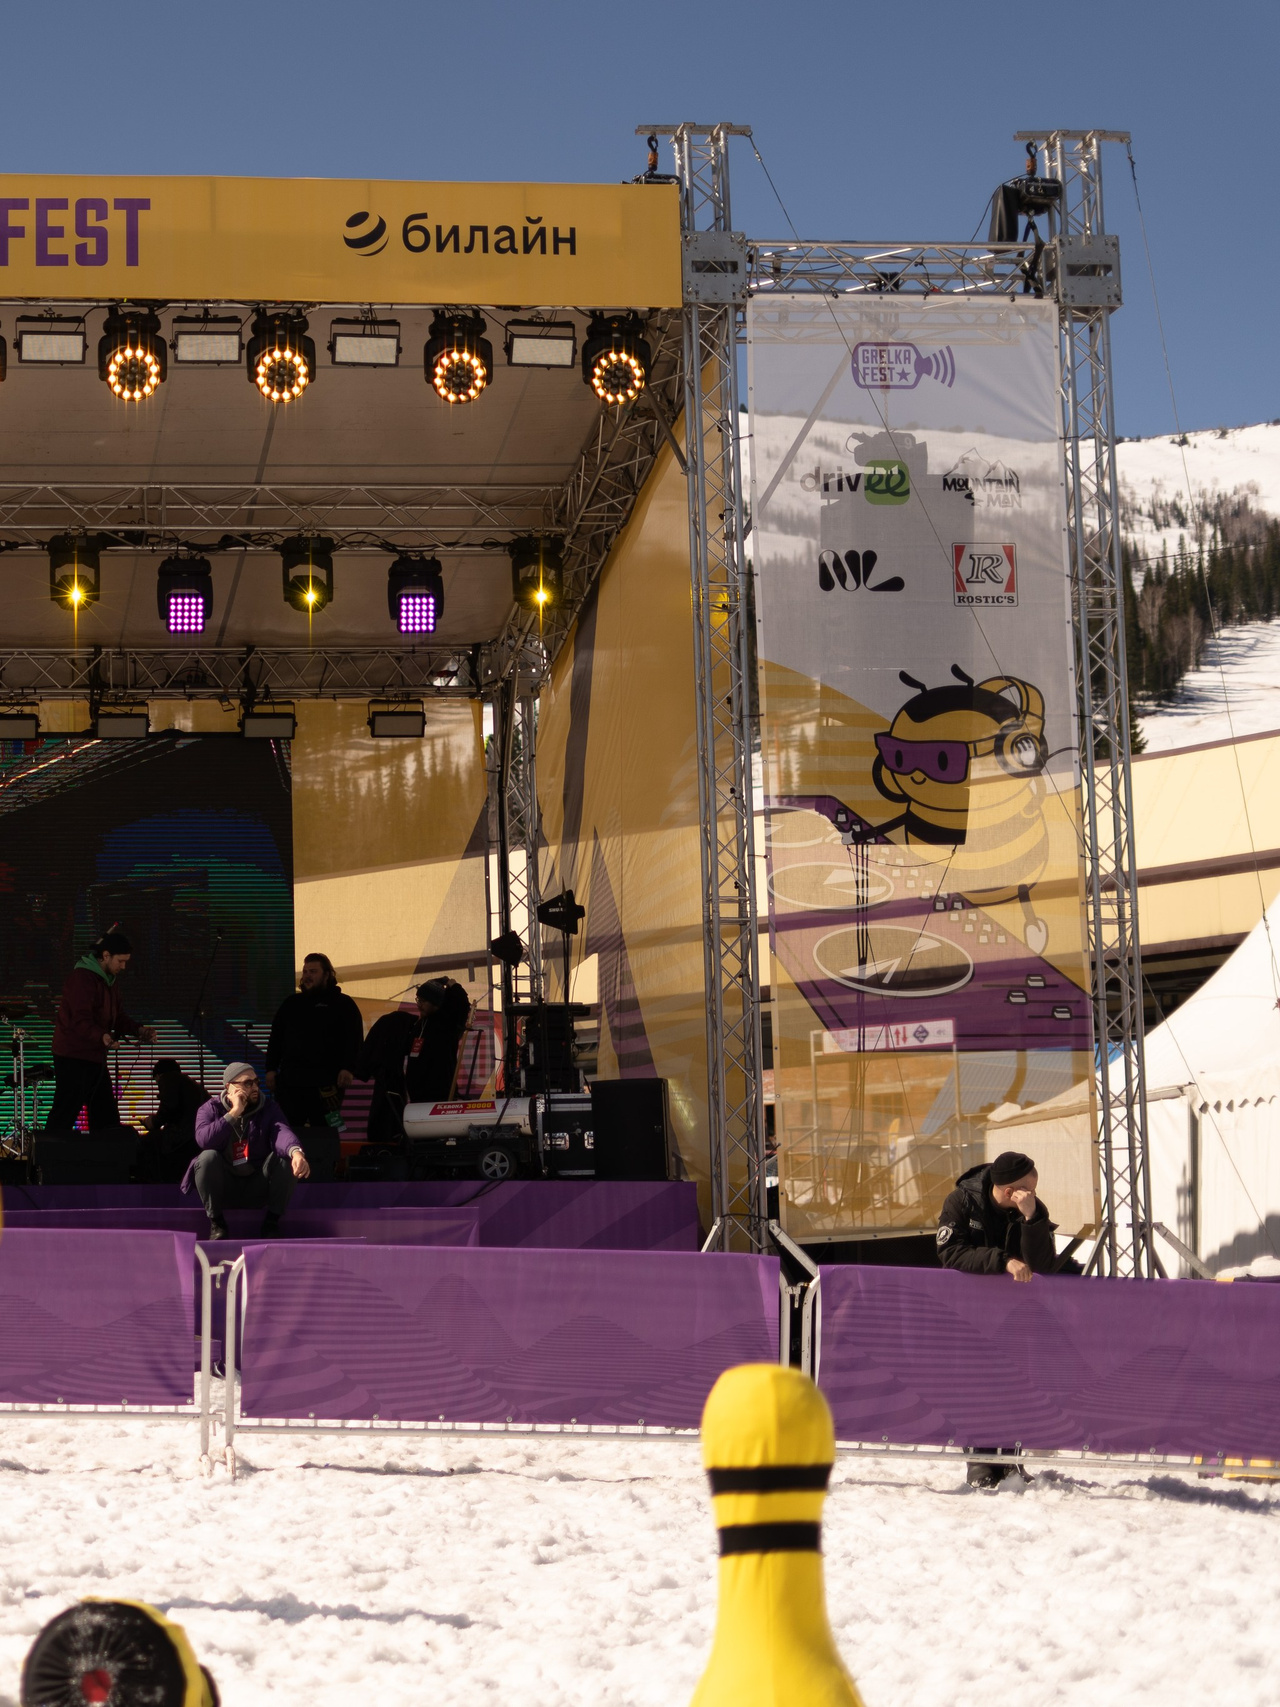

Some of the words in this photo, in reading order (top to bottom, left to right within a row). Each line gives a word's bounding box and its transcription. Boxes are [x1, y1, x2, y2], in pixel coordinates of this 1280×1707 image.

[402, 212, 577, 256] билайн
[862, 349, 912, 365] GRELKA
[862, 367, 896, 382] FEST
[800, 465, 910, 498] drivee
[957, 595, 1015, 604] ROSTIC'S
